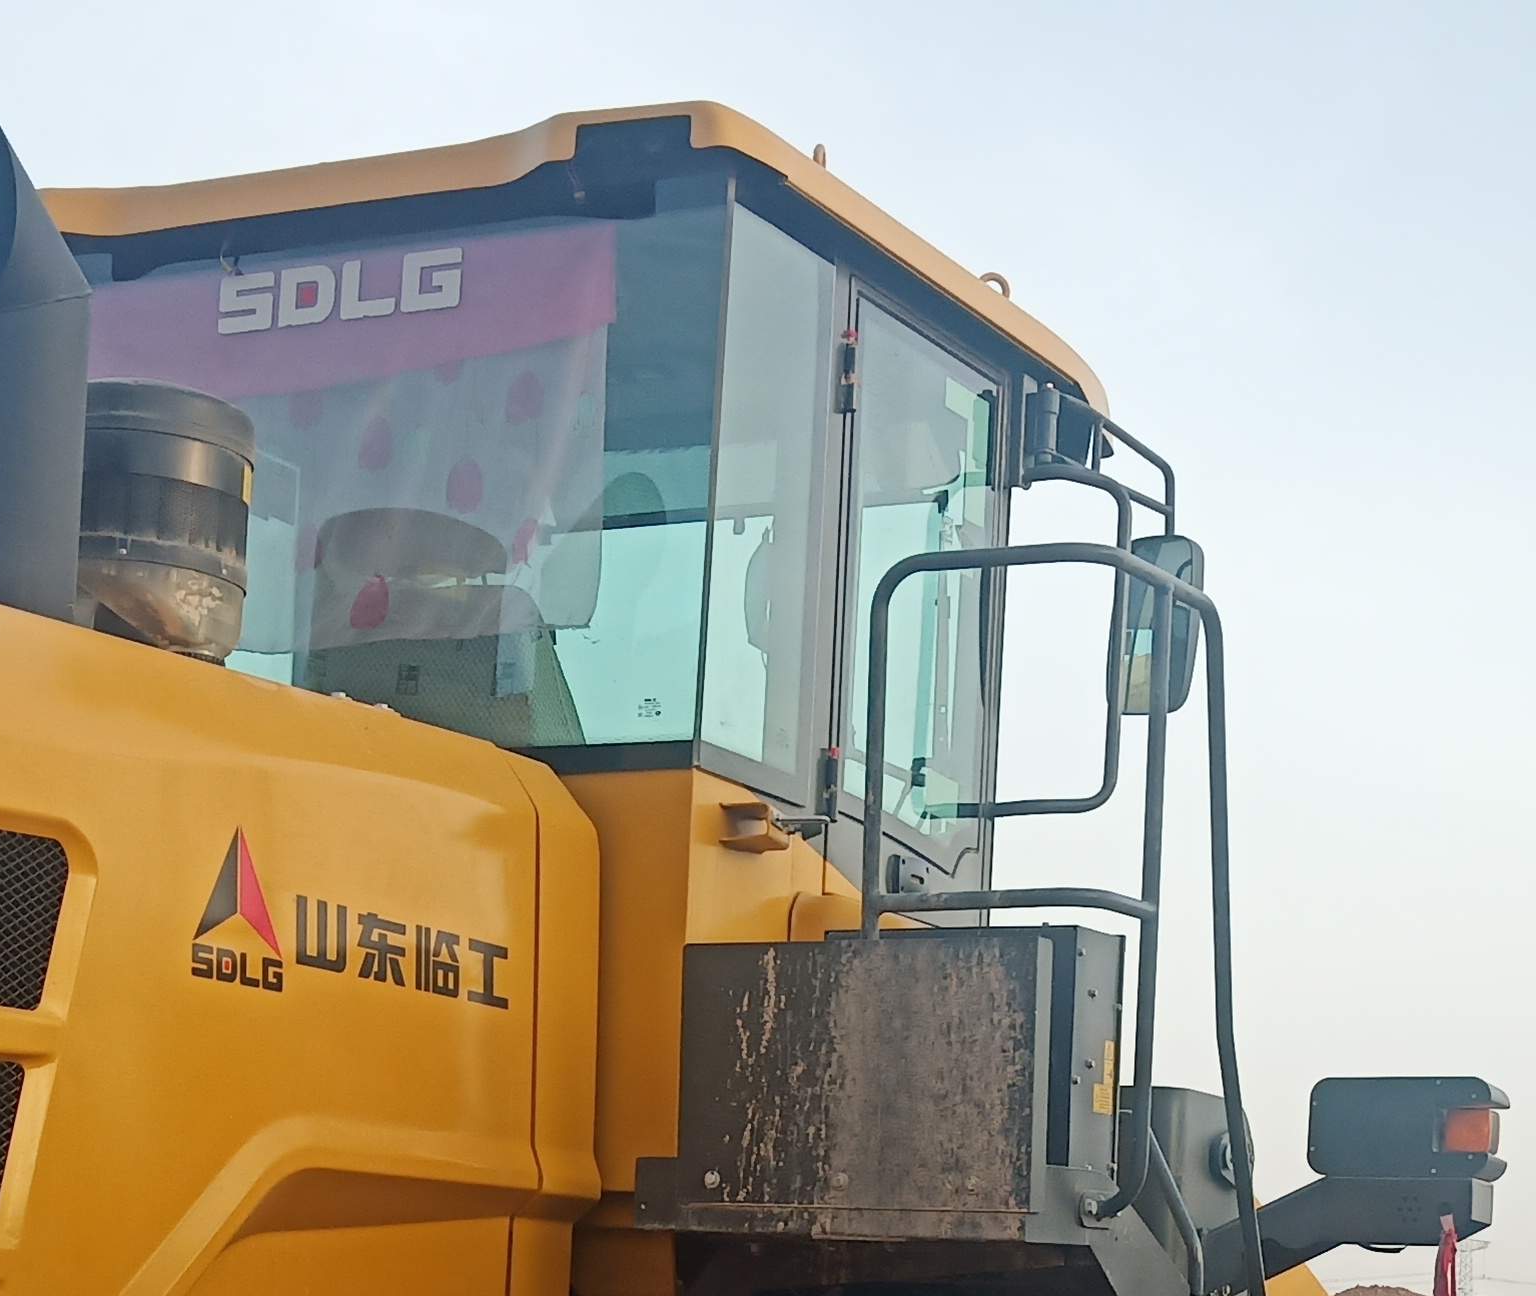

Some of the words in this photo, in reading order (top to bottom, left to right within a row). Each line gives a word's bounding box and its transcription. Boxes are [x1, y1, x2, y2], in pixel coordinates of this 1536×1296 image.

[218, 248, 463, 335] SDLG
[191, 943, 283, 992] SDLG
[296, 894, 509, 1010] 山东临工
